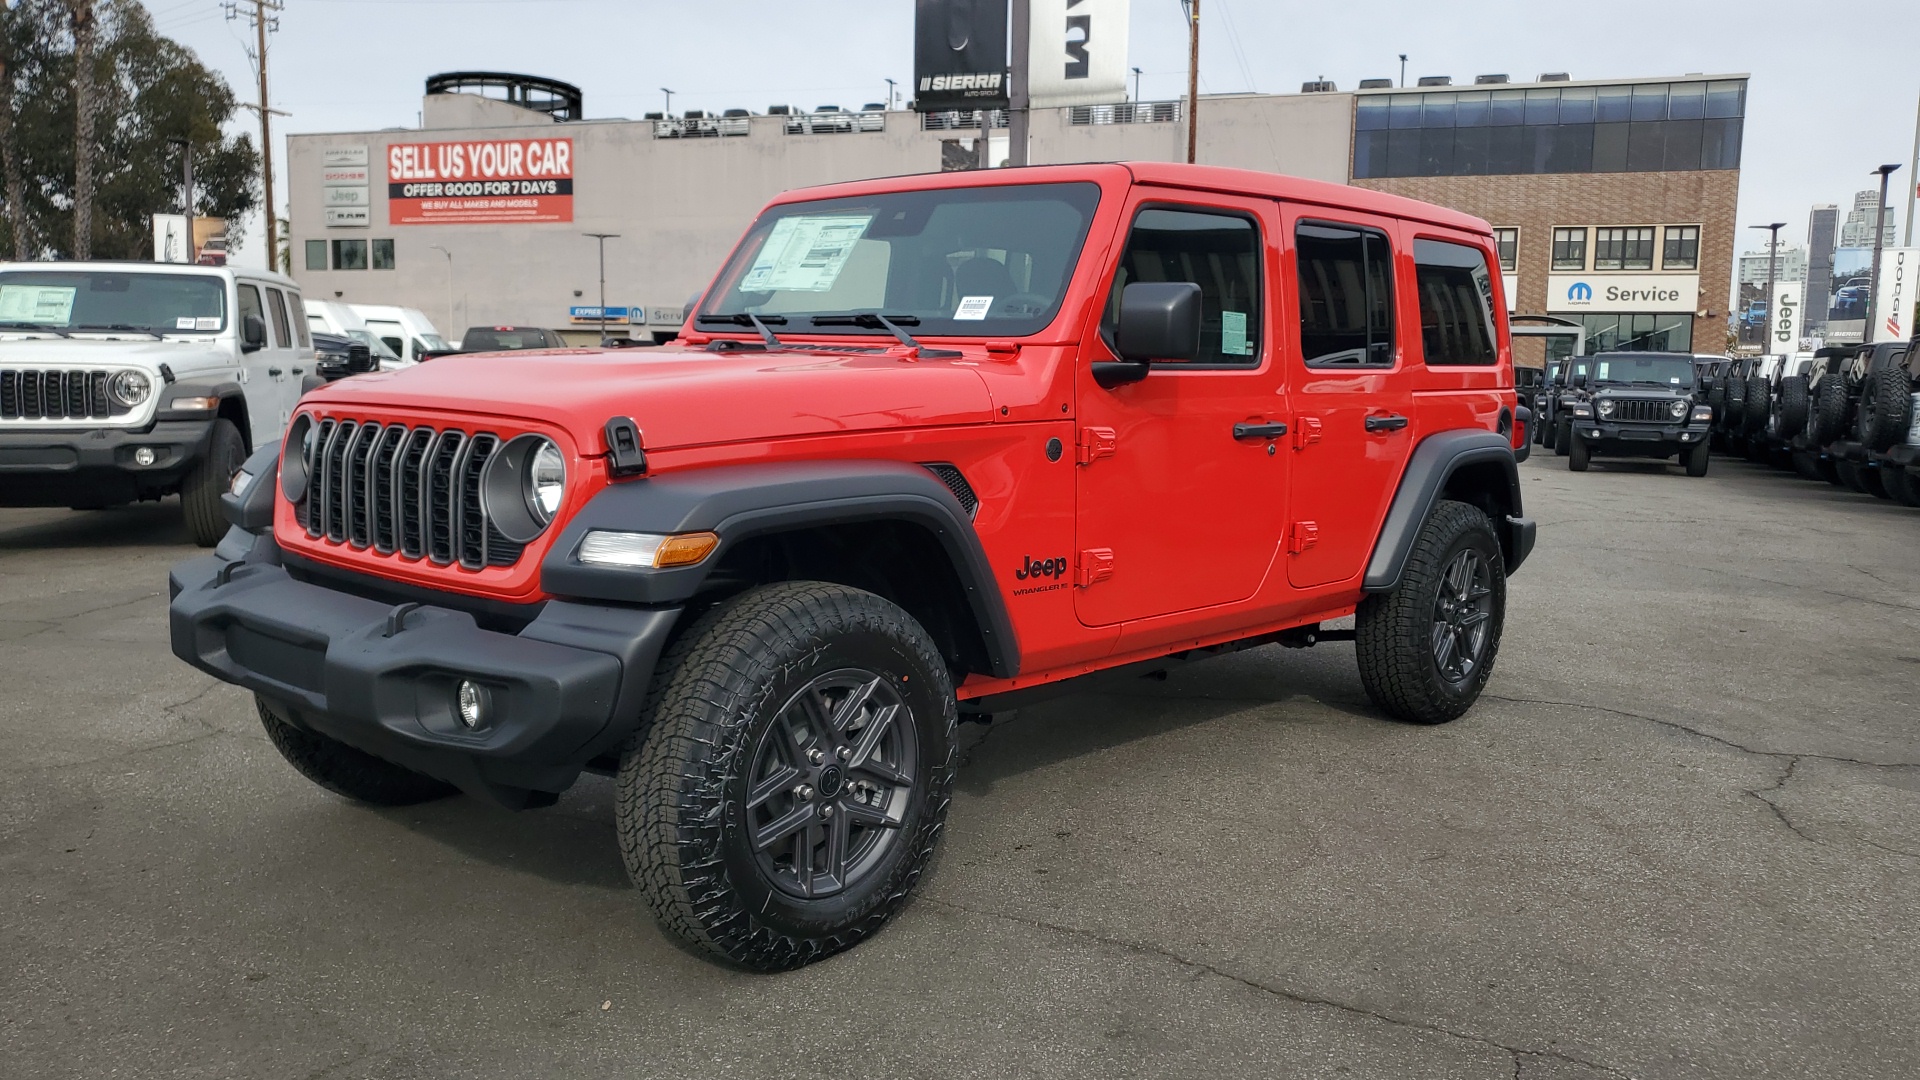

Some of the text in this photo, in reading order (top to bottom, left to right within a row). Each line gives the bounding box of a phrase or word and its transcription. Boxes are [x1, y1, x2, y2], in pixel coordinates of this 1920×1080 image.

[932, 74, 1001, 90] SIERRA
[390, 141, 571, 180] SELL US YOUR CAR
[332, 190, 358, 202] Jeep
[403, 180, 557, 197] OFFER GOOD FOR 7 DAYS
[421, 199, 538, 210] WE BUY ALL MAKES AND MODELS
[1606, 286, 1679, 302] Service
[1891, 251, 1904, 326] DODGE
[1775, 294, 1797, 342] Jeep
[1016, 555, 1066, 580] Jeep
[1013, 584, 1060, 596] WRANGLER
